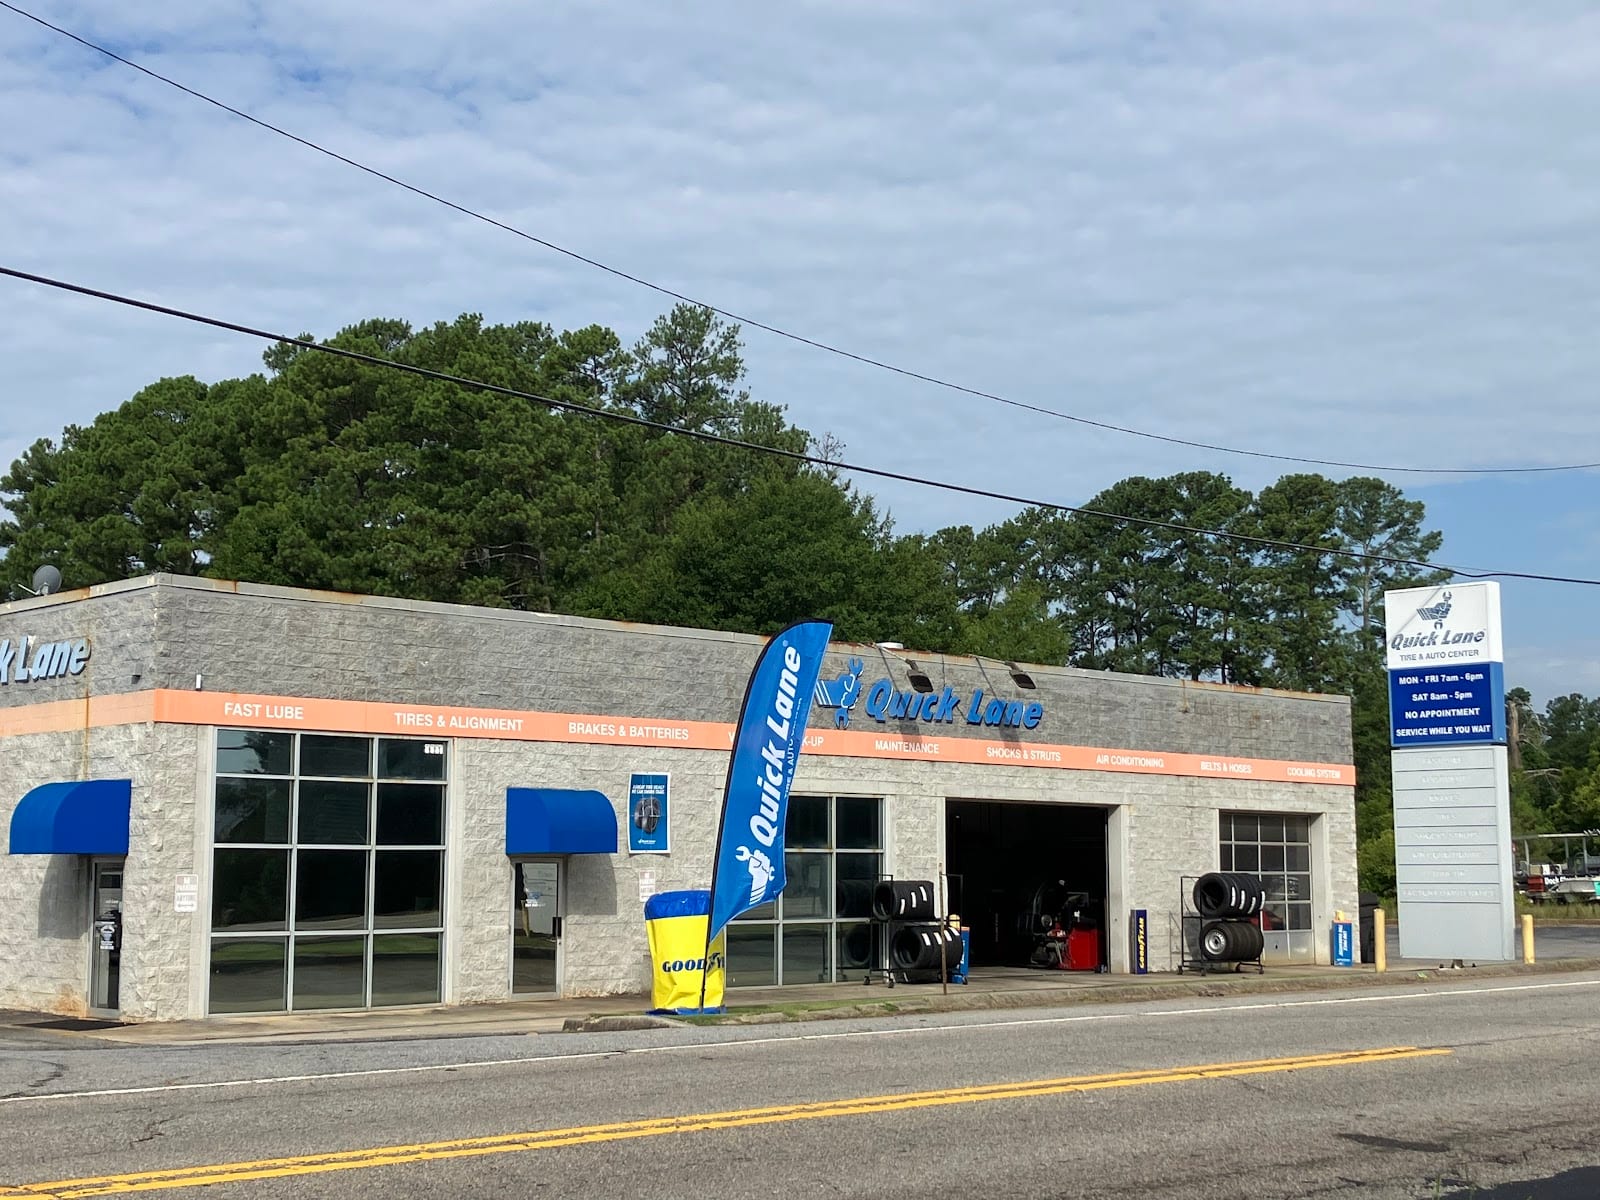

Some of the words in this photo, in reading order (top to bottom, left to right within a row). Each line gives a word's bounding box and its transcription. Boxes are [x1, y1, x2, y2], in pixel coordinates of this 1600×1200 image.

[1391, 631, 1438, 650] Quick
[1441, 630, 1485, 646] Lane
[15, 635, 91, 682] Lane
[1400, 653, 1417, 662] TIRE
[1418, 653, 1424, 661] &
[1425, 651, 1446, 660] AUTO
[1448, 649, 1479, 659] CENTER
[1399, 676, 1419, 685] MON
[1425, 675, 1439, 683] FRI
[1440, 674, 1459, 683] 7am
[1465, 672, 1484, 682] 6pm
[767, 646, 801, 740] Lane
[1412, 693, 1428, 702] SAT
[1430, 692, 1448, 701] 8am
[1454, 691, 1473, 701] 5pm
[224, 702, 262, 718] FAST
[265, 704, 304, 719] LUBE
[866, 678, 960, 723] Quick
[967, 688, 1043, 730] Lane
[1405, 711, 1418, 719] NO
[1419, 707, 1480, 719] APPOINTMENT
[394, 712, 433, 727] TIRES
[437, 715, 446, 727] &
[449, 715, 523, 731] ALIGNMENT
[568, 721, 615, 736] BRAKES
[618, 725, 627, 737] &
[629, 725, 689, 740] BATTERIES
[1396, 727, 1428, 737] SERVICE
[1429, 726, 1453, 735] WHILE
[1454, 725, 1470, 734] YOU
[1471, 725, 1491, 733] WAIT
[875, 740, 940, 754] MAINTENANCE
[987, 747, 1021, 760] SHOCKS
[1023, 750, 1029, 760] &
[1030, 750, 1061, 761] STRUTS
[1096, 754, 1109, 765] AIR
[1110, 755, 1164, 768] CONDITIONING
[1200, 760, 1220, 771] BELTS
[1222, 762, 1228, 771] &
[1229, 763, 1252, 774] HOSES
[1287, 767, 1315, 777] COOLING
[1317, 768, 1341, 779] SYSTEM
[749, 739, 786, 847] Quick
